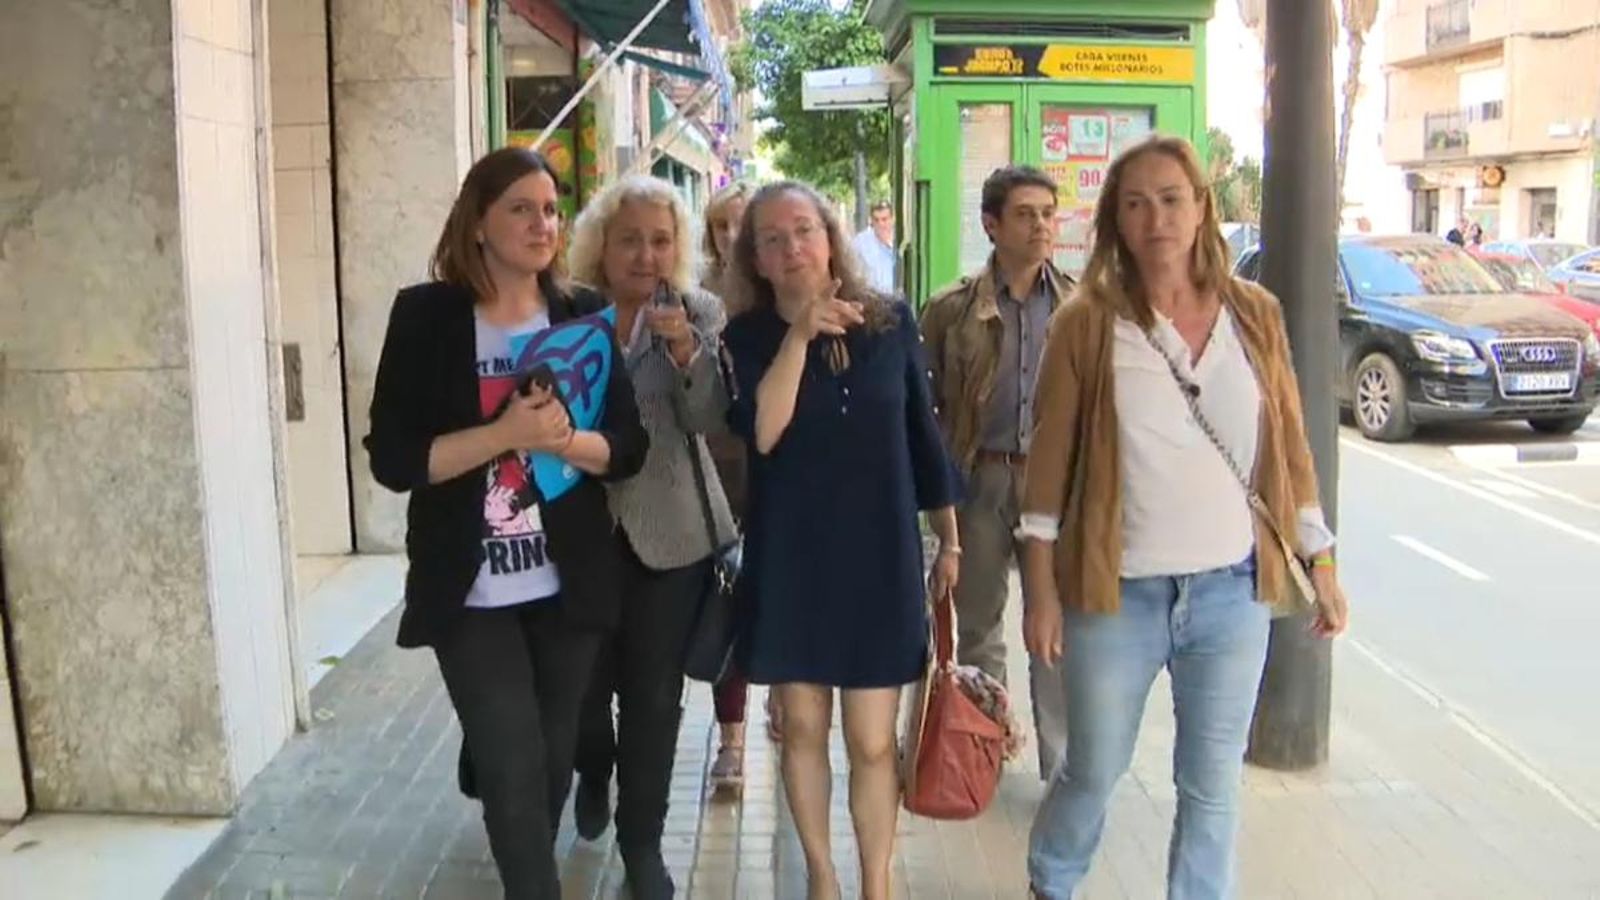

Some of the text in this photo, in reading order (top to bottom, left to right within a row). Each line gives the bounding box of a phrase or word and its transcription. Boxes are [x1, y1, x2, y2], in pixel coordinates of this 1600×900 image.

[1075, 52, 1148, 62] CADA VIERNES
[1060, 62, 1091, 72] BOTES
